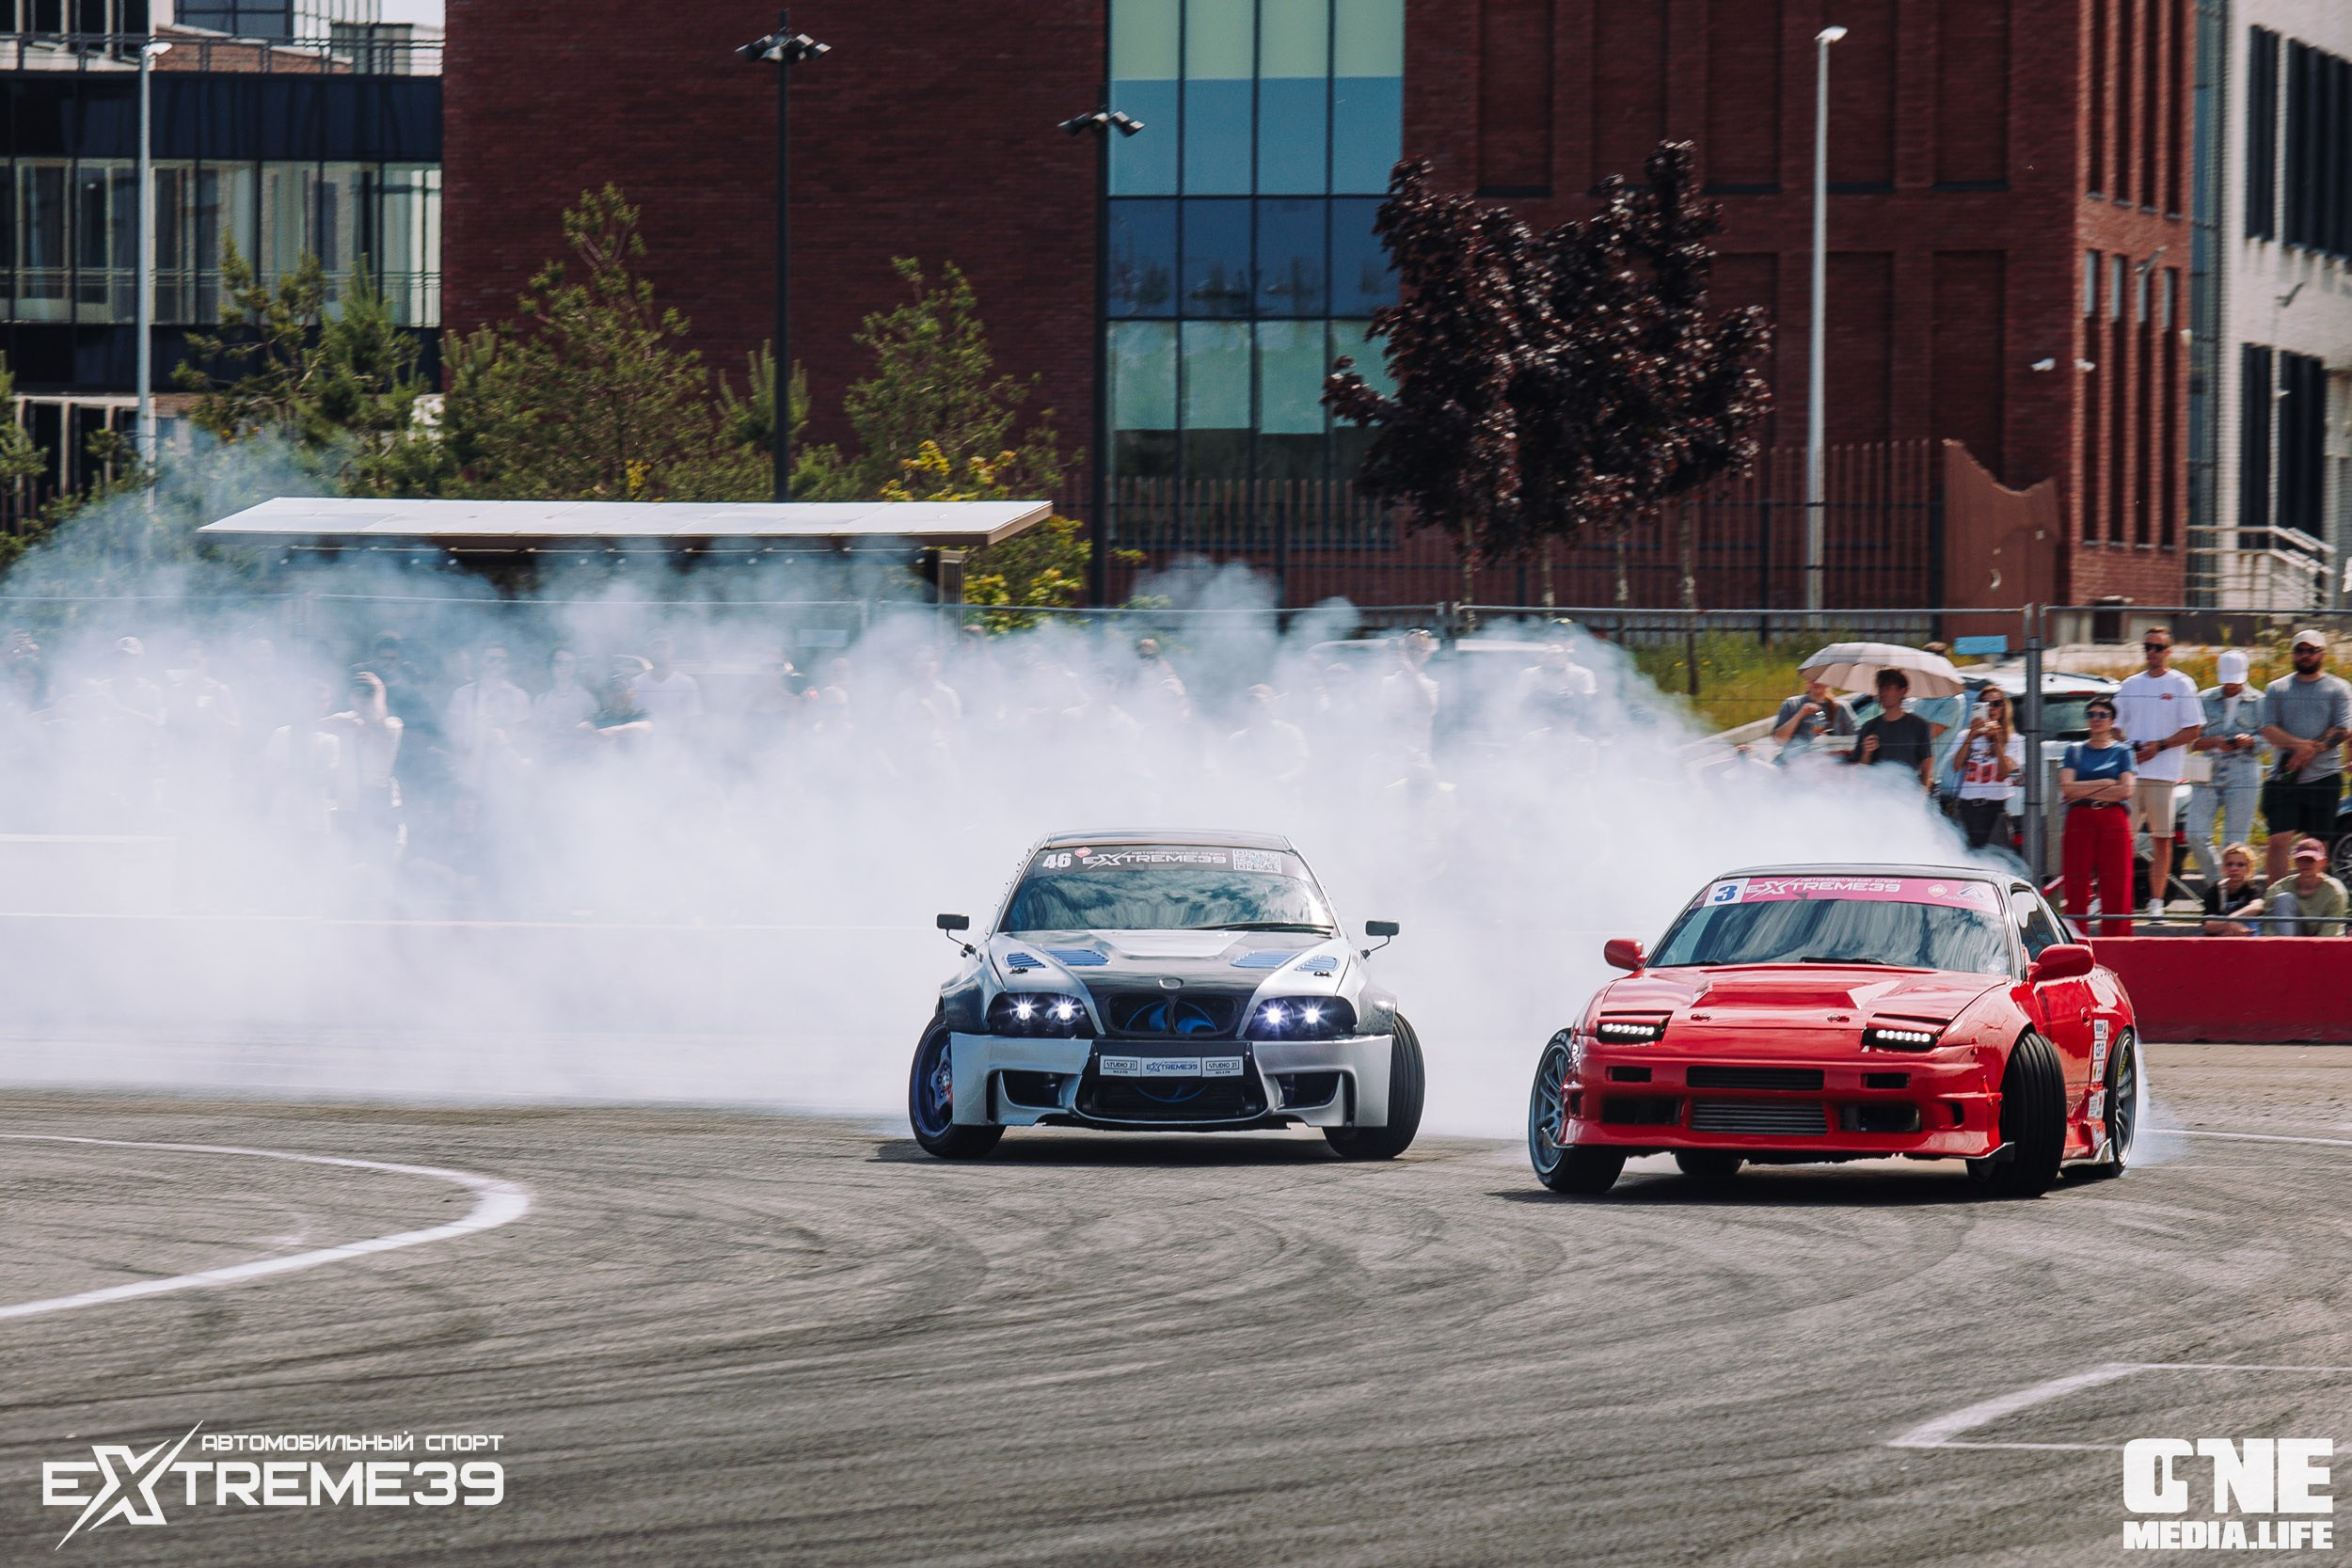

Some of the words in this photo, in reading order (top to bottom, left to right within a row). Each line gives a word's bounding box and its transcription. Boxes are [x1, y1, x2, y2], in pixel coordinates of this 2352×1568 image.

[1042, 853, 1072, 869] 46
[1082, 851, 1227, 870] EXTREME39
[1714, 885, 1738, 902] 3
[1745, 877, 1901, 901] EXTREME39
[1146, 1060, 1198, 1073] EXTREME39
